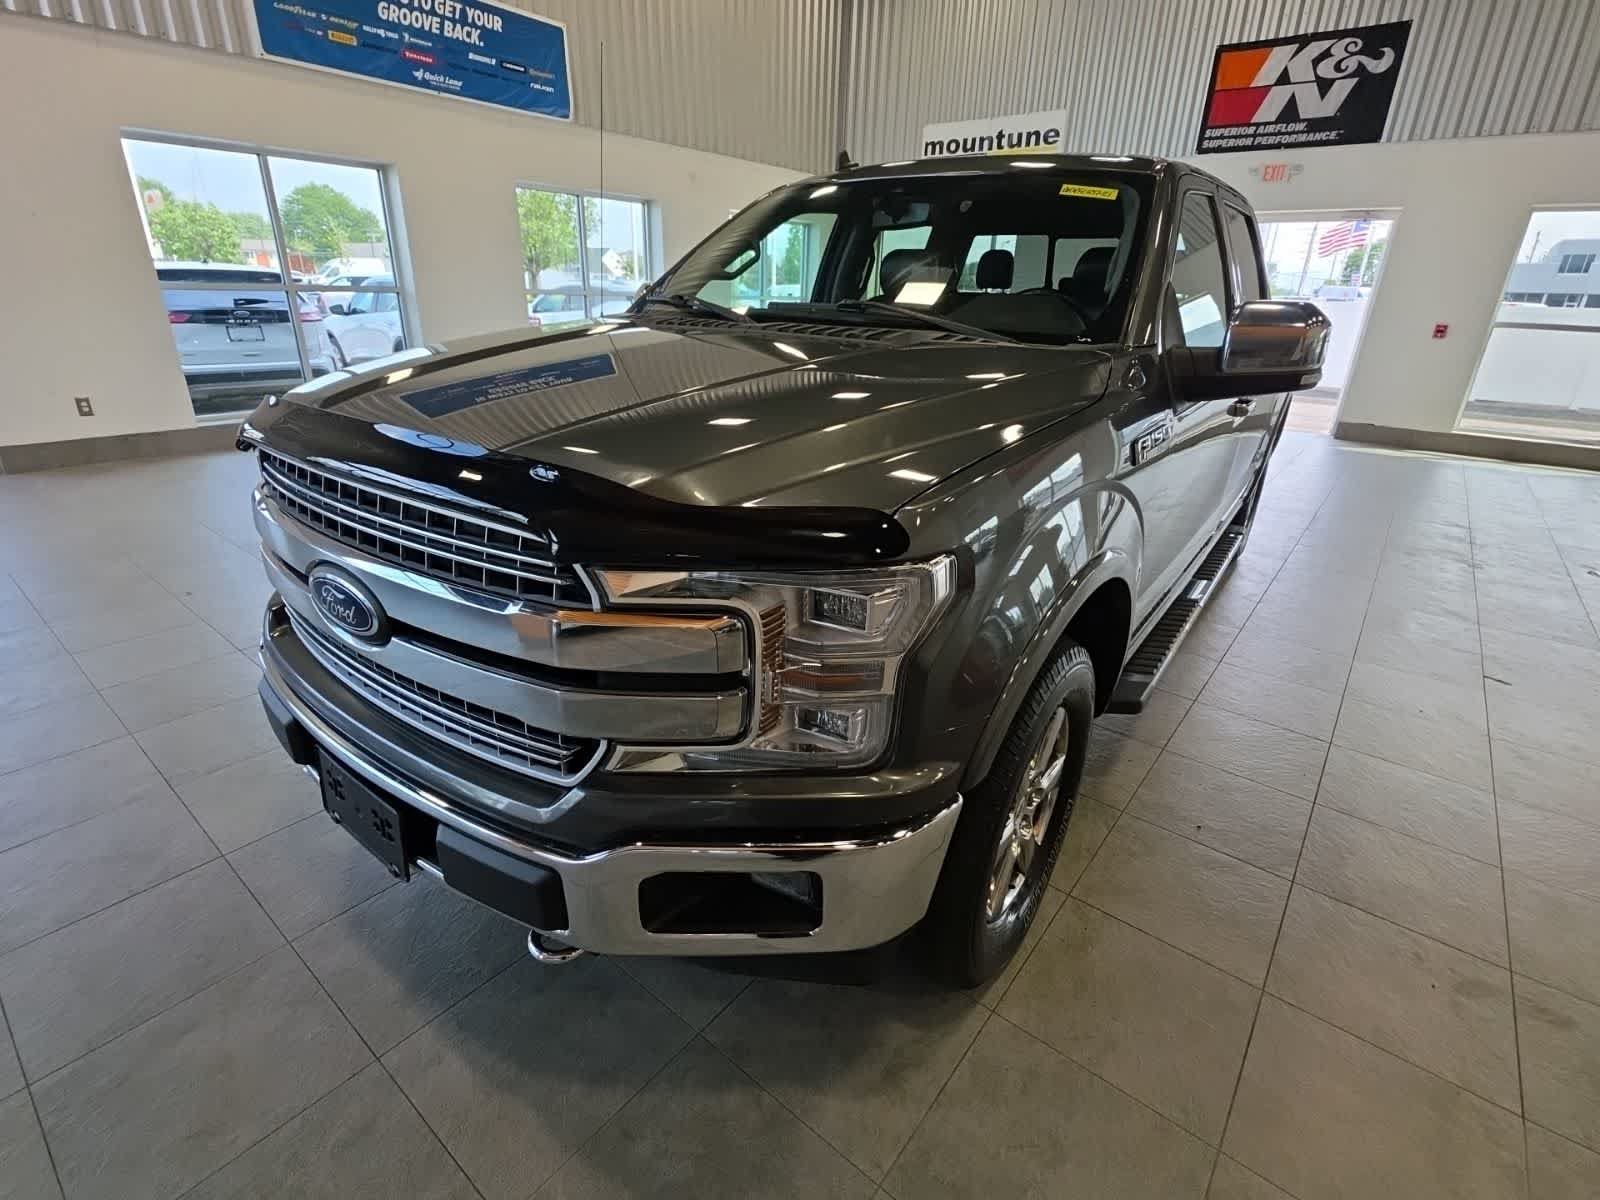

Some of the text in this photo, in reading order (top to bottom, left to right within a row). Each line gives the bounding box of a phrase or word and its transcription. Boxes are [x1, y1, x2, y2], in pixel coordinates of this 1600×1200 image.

[378, 1, 441, 34] GROOVE
[444, 20, 485, 47] BACK.
[435, 0, 463, 19] GET
[465, 6, 503, 32] YOUR
[424, 71, 444, 83] Quick
[445, 76, 463, 87] Lane
[924, 128, 1060, 156] mountune
[1202, 137, 1252, 148] SUPERIOR
[1204, 127, 1255, 138] SUPERIOR
[1263, 164, 1289, 183] EXIT
[320, 585, 357, 625] Ford
